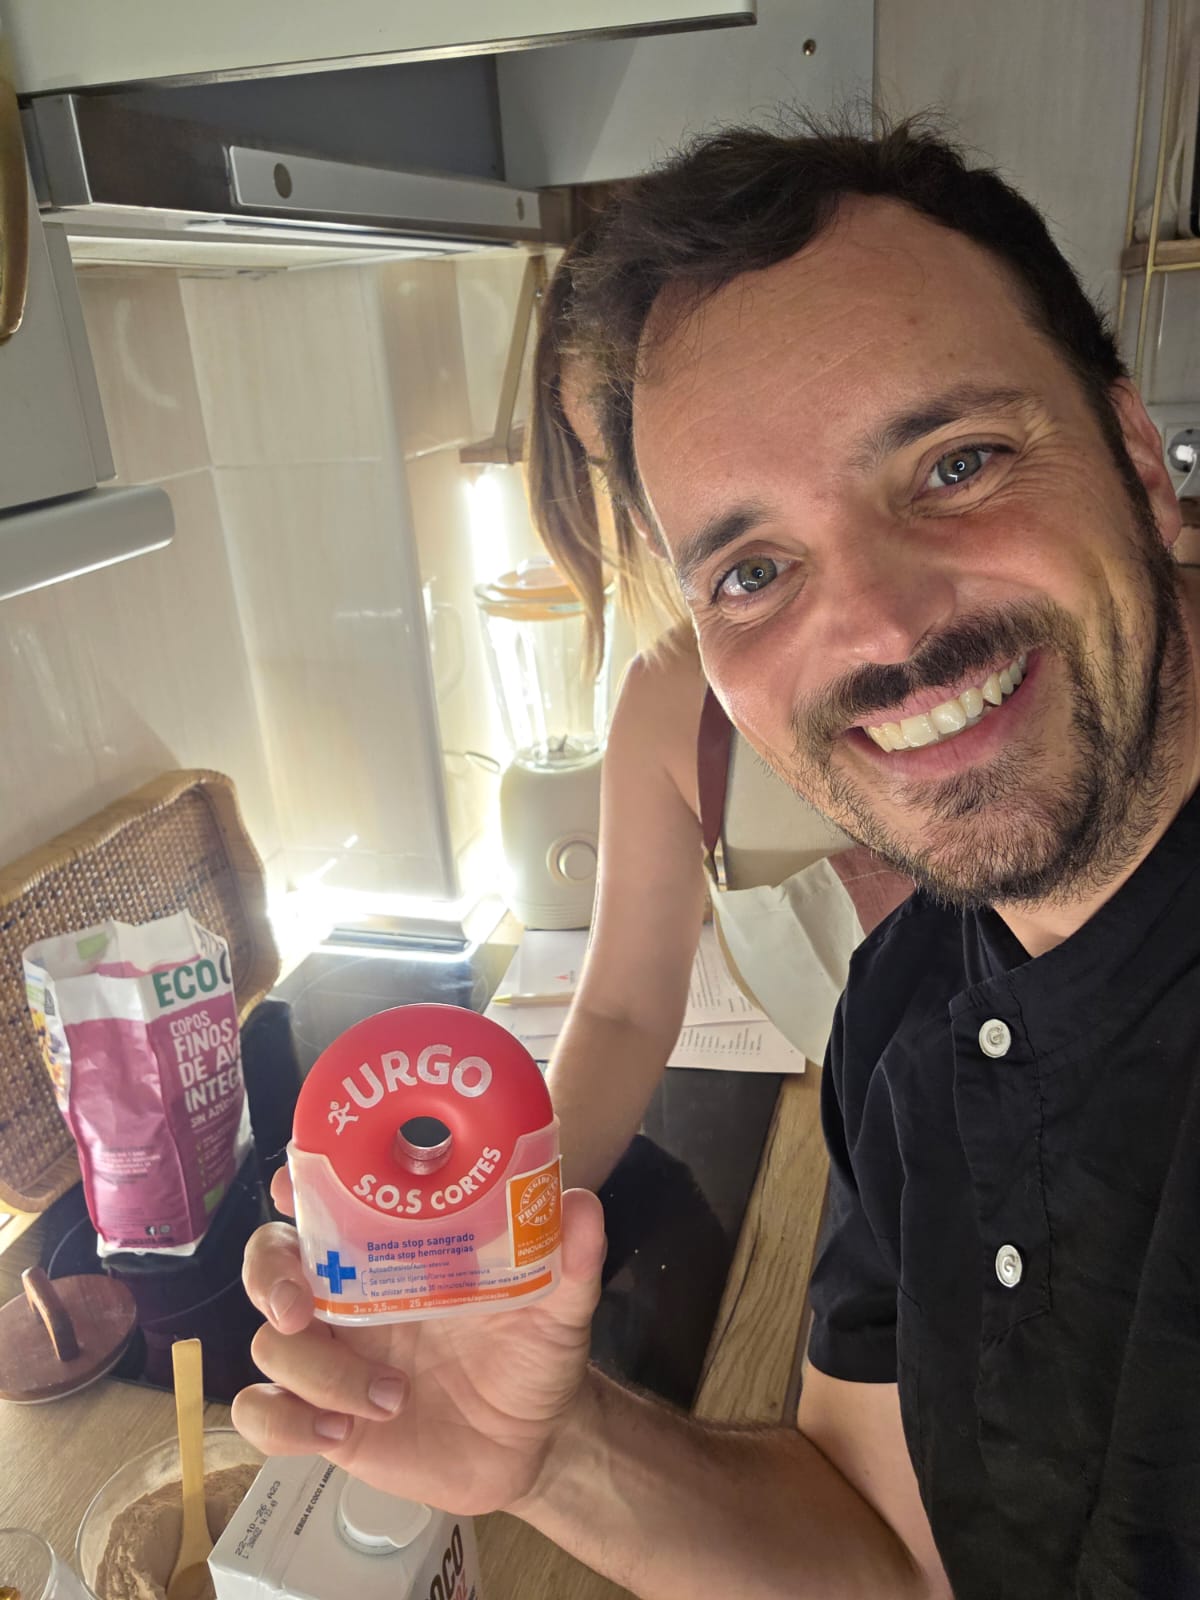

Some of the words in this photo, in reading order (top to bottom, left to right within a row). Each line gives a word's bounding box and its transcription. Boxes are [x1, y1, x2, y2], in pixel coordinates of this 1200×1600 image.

[169, 1010, 211, 1037] COPOS
[174, 1018, 233, 1063] FINOS
[179, 1056, 208, 1088] DE
[341, 1044, 493, 1109] URGO
[352, 1174, 423, 1214] S.O.S
[430, 1146, 502, 1211] CORTES
[367, 1240, 400, 1252] Banda
[402, 1239, 424, 1249] stop
[426, 1232, 475, 1246] sangrado
[368, 1252, 396, 1262] Banda
[397, 1251, 416, 1260] stop
[417, 1245, 474, 1257] hemorragias
[408, 1298, 422, 1308] 25
[294, 1513, 310, 1536] BEBIDA
[310, 1487, 323, 1505] COCO
